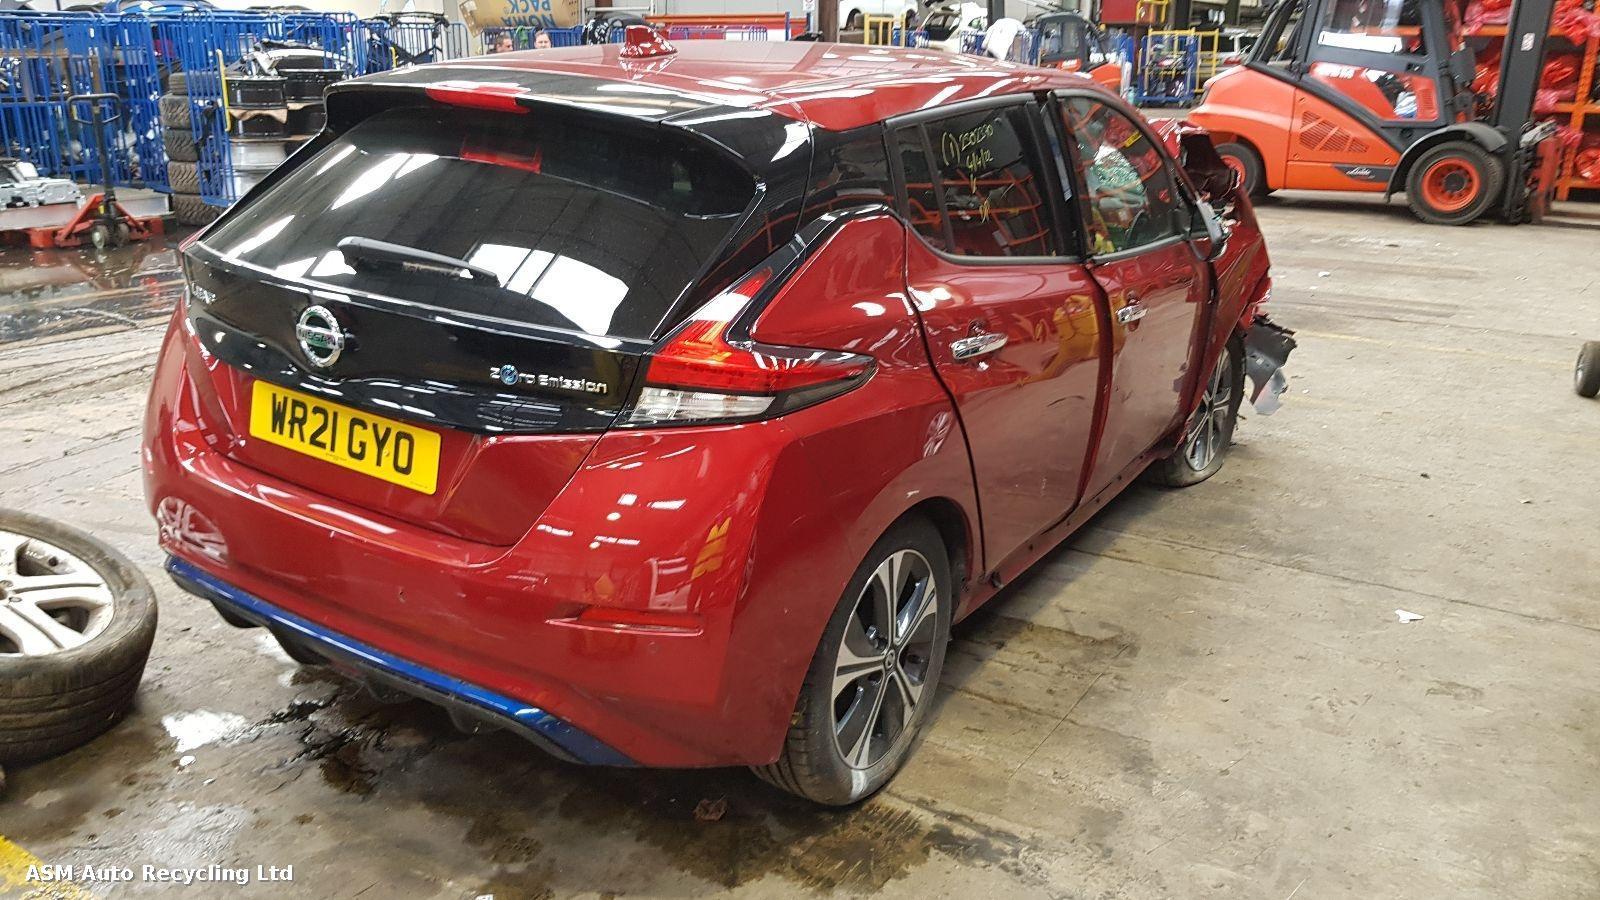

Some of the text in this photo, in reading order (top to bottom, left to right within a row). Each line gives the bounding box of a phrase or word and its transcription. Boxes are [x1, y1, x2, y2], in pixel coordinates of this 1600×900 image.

[509, 0, 551, 14] PACK
[271, 392, 416, 477] WR21 GYO
